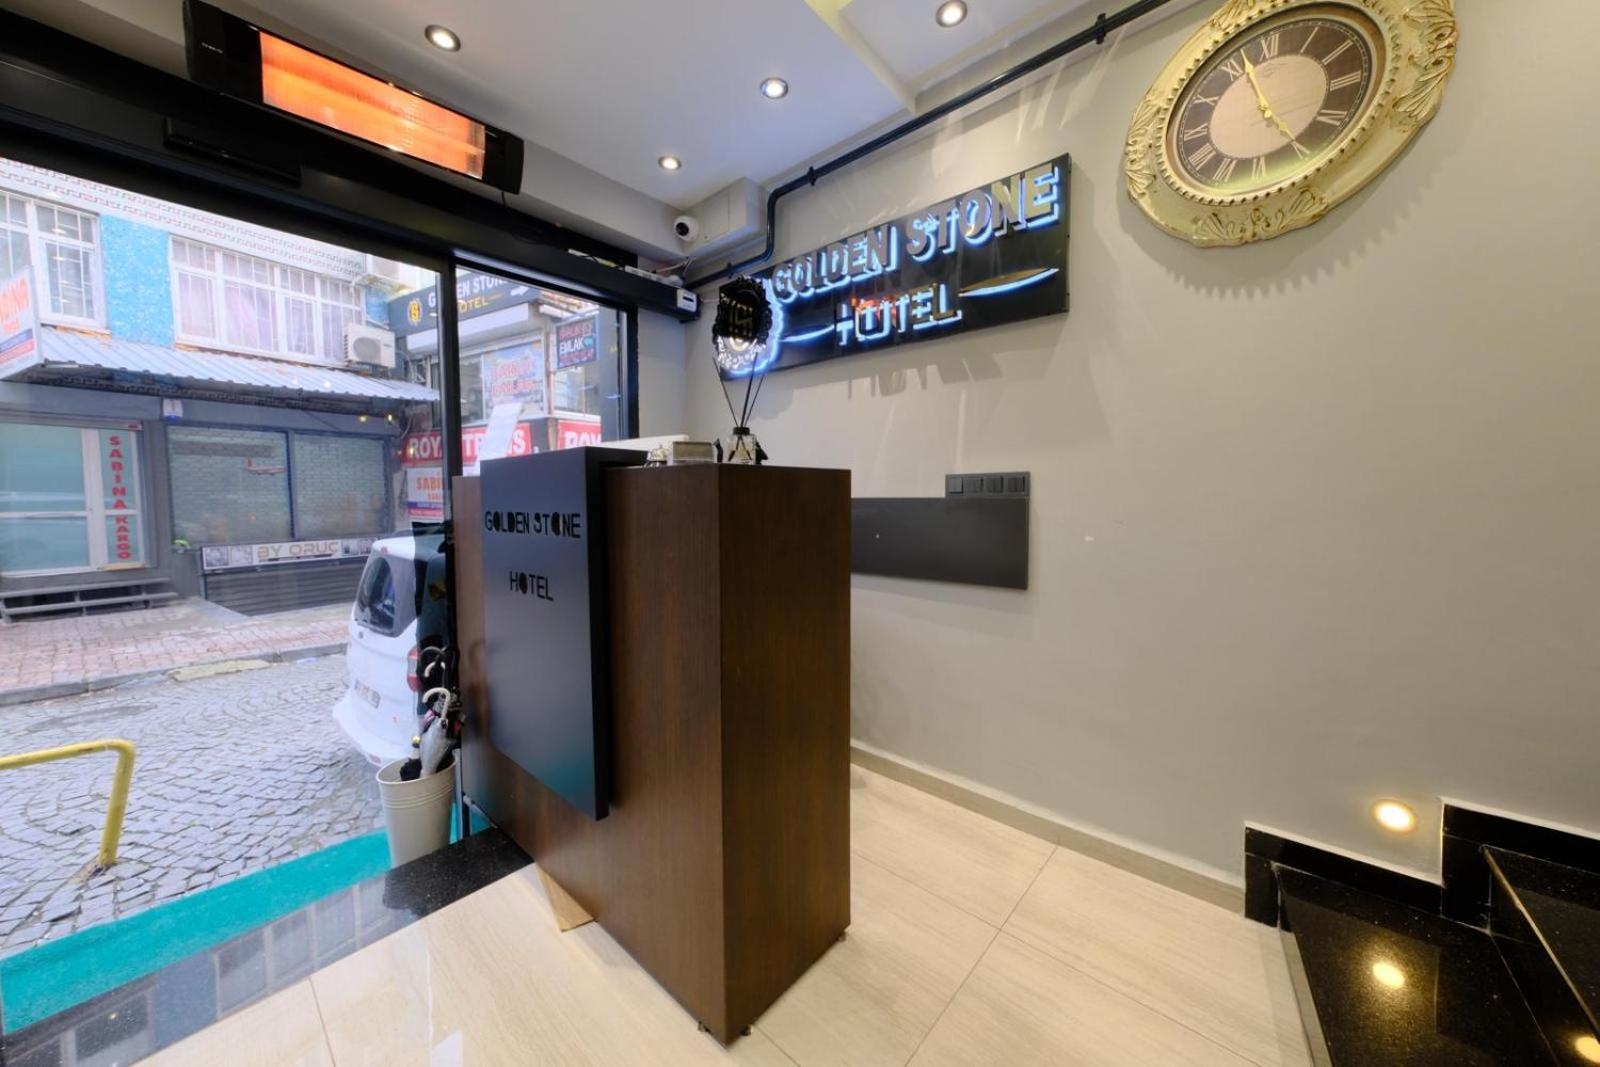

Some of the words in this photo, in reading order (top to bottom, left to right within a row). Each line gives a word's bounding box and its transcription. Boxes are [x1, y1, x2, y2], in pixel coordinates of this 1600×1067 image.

[1259, 32, 1280, 61] XII
[1221, 57, 1245, 82] XI
[771, 223, 899, 304] GOLDEN
[905, 164, 1061, 264] STONE
[835, 282, 963, 346] HOTEL
[108, 435, 128, 510] SABINA
[484, 511, 530, 535] GOLDEN
[533, 511, 581, 539] STONE
[509, 570, 554, 602] HOTEL
